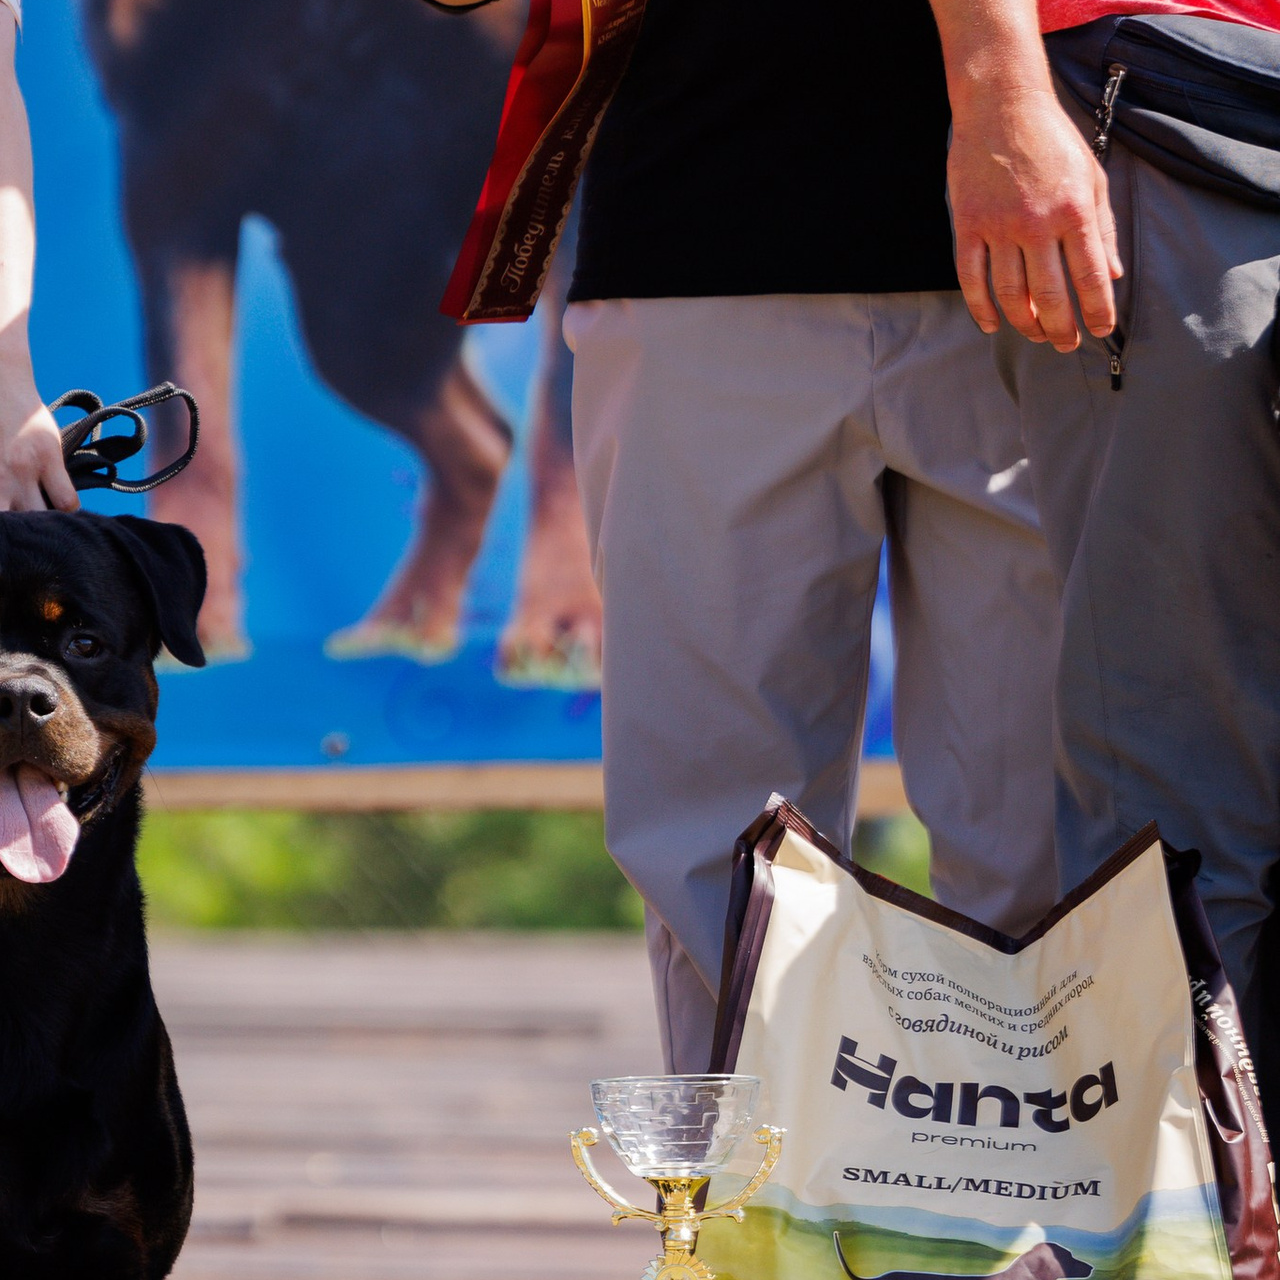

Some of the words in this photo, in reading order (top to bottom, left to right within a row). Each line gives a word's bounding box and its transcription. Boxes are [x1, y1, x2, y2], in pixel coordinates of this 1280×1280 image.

[500, 150, 565, 294] Победитель
[901, 971, 945, 985] сухой
[947, 978, 1058, 1018] полнорационный
[1059, 970, 1078, 992] для
[906, 988, 952, 1004] собак
[954, 997, 1005, 1029] мелких
[1007, 1021, 1017, 1033] и
[1020, 999, 1065, 1034] средних
[1064, 974, 1095, 1006] пород
[895, 1013, 999, 1052] говядиной
[1000, 1042, 1014, 1056] и
[1016, 1025, 1069, 1061] рисом
[830, 1034, 1119, 1133] Hanta
[911, 1131, 1037, 1152] premium
[842, 1166, 1102, 1201] SMALL/MEDIUM
